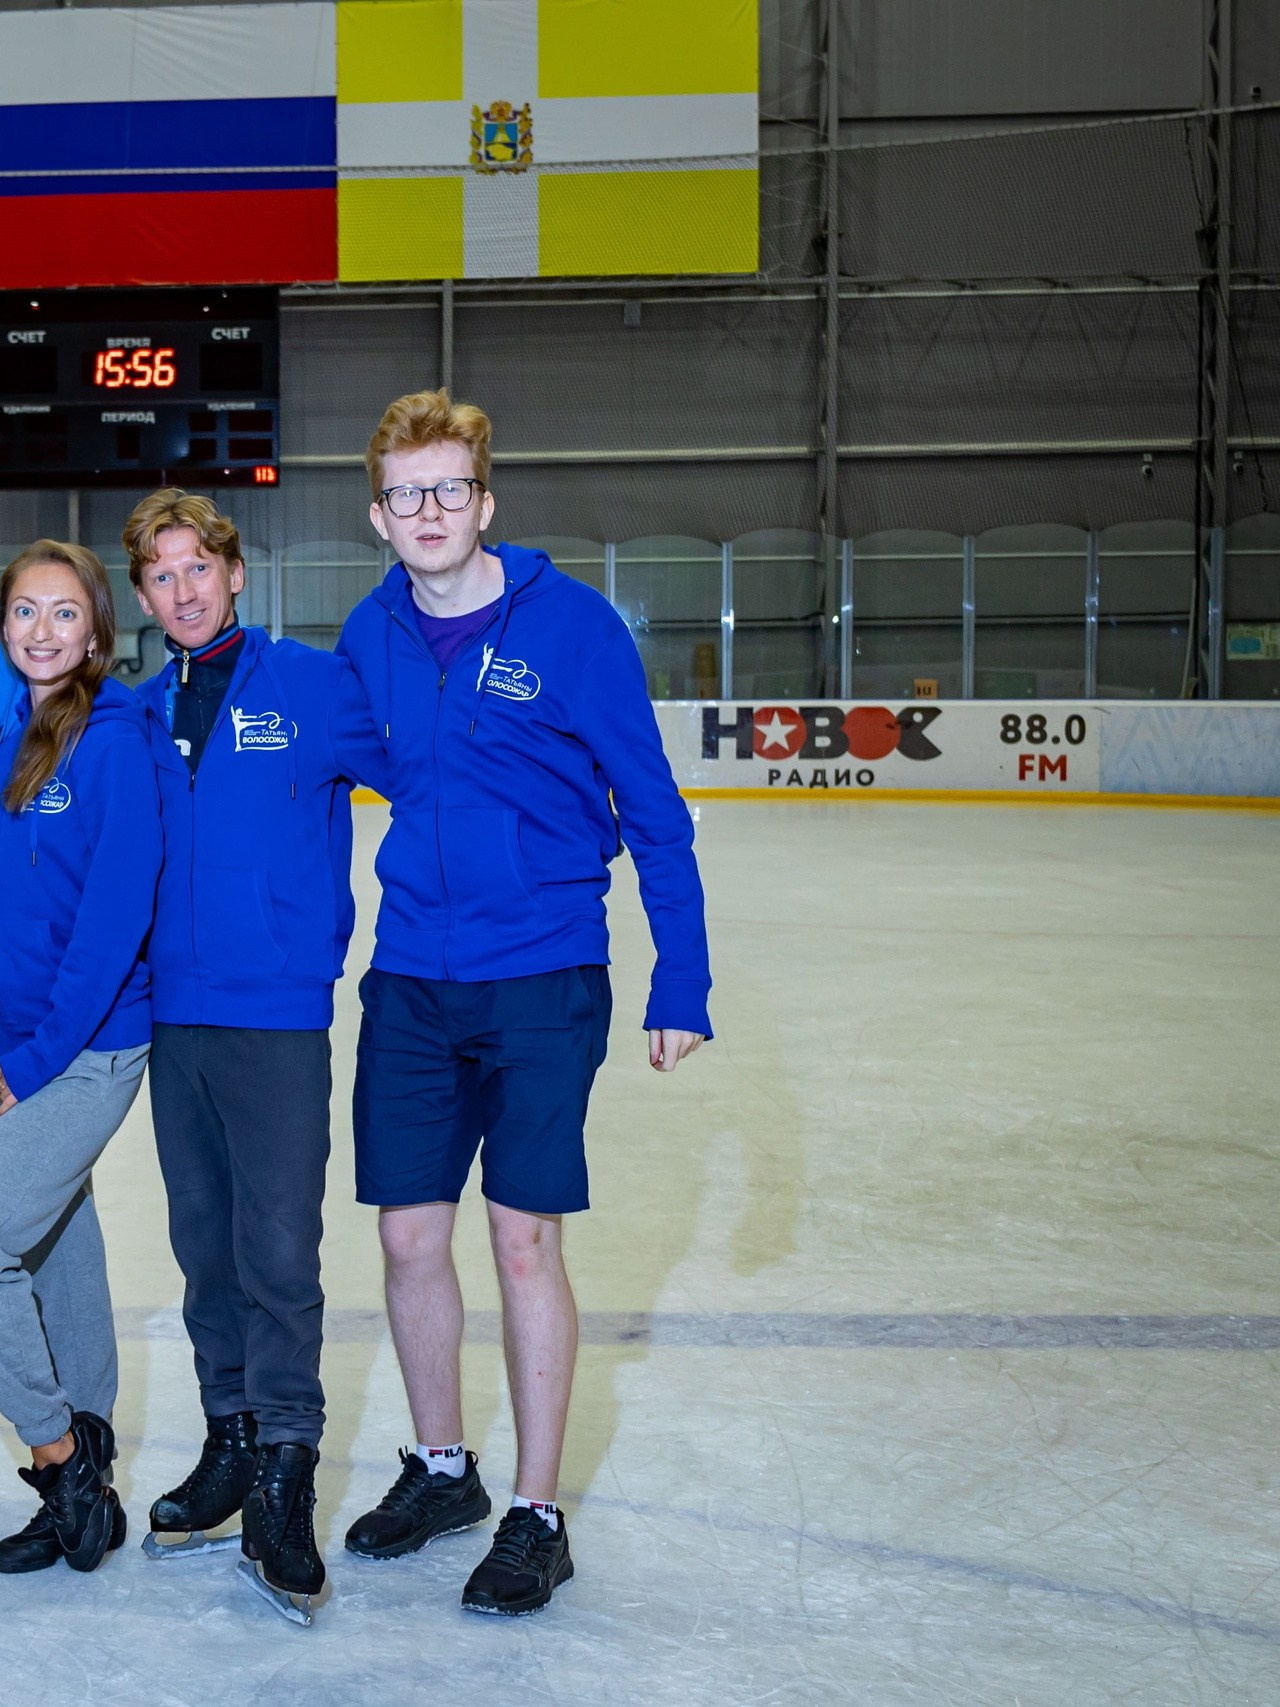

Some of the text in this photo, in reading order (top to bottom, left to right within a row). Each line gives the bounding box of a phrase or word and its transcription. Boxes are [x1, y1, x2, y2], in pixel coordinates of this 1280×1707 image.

[8, 331, 46, 343] СЧЕТ
[211, 328, 250, 340] СЧЕТ
[106, 337, 151, 348] ВРЕМЯ
[95, 349, 176, 388] 15:56
[101, 411, 155, 424] ПЕРИОД
[487, 680, 529, 697] ОЛОСОЖАР
[1000, 713, 1086, 745] 88.0
[1019, 754, 1067, 782] FM
[768, 769, 875, 788] РАДИО
[429, 1446, 463, 1458] FILA
[530, 1502, 557, 1514] FIL
